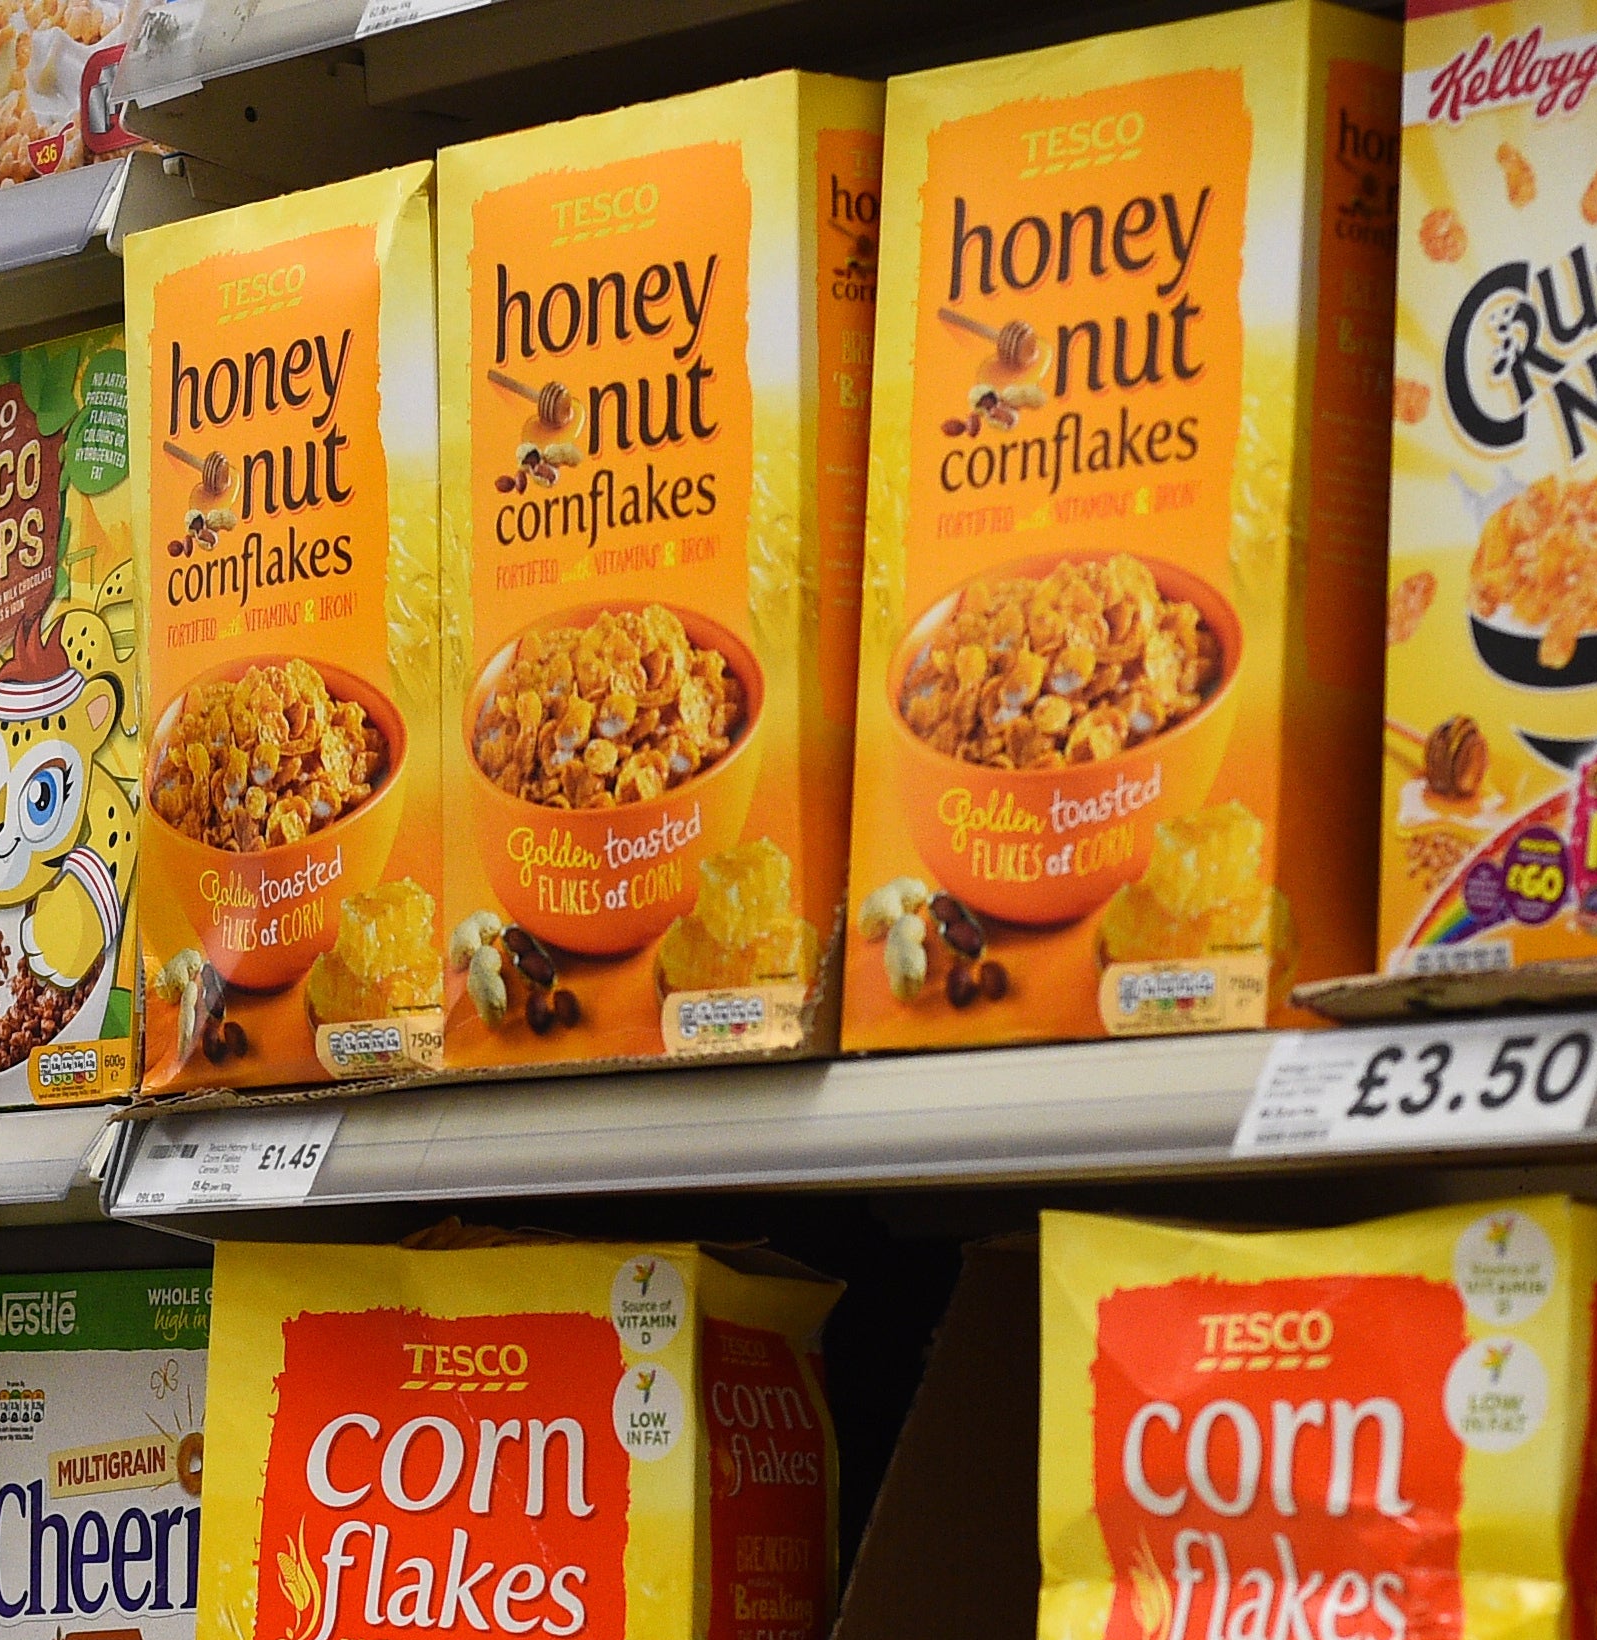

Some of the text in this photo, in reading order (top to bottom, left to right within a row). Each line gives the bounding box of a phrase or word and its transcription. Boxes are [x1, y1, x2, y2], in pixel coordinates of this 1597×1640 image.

[949, 186, 1212, 301] honey
[218, 262, 307, 310] TESCO
[494, 253, 721, 366] honey
[1054, 292, 1204, 399] nut
[168, 328, 355, 438] honey
[587, 358, 721, 456] nut
[75, 448, 126, 468] HYDROGENATED
[84, 429, 125, 448] COLOURS OR
[939, 411, 1201, 496] cornflakes
[91, 466, 104, 480] FAT
[241, 422, 355, 523] nut
[494, 461, 718, 548] cornflakes
[3, 585, 18, 602] MILK
[18, 566, 52, 594] CHOCOLATE
[166, 531, 354, 606] cornflakes
[200, 845, 343, 925] Golden toasted
[104, 1054, 126, 1069] 600g
[410, 1029, 442, 1049] 750g
[1346, 1030, 1596, 1119] £3.50
[258, 1144, 321, 1171] £1.45
[618, 1315, 676, 1328] VITAMIN
[642, 1332, 651, 1345] D
[402, 1343, 529, 1376] TESCO
[628, 1430, 671, 1445] IN FAT
[630, 1412, 667, 1428] LOW
[306, 1411, 595, 1517] corn
[1122, 1397, 1415, 1518] corn
